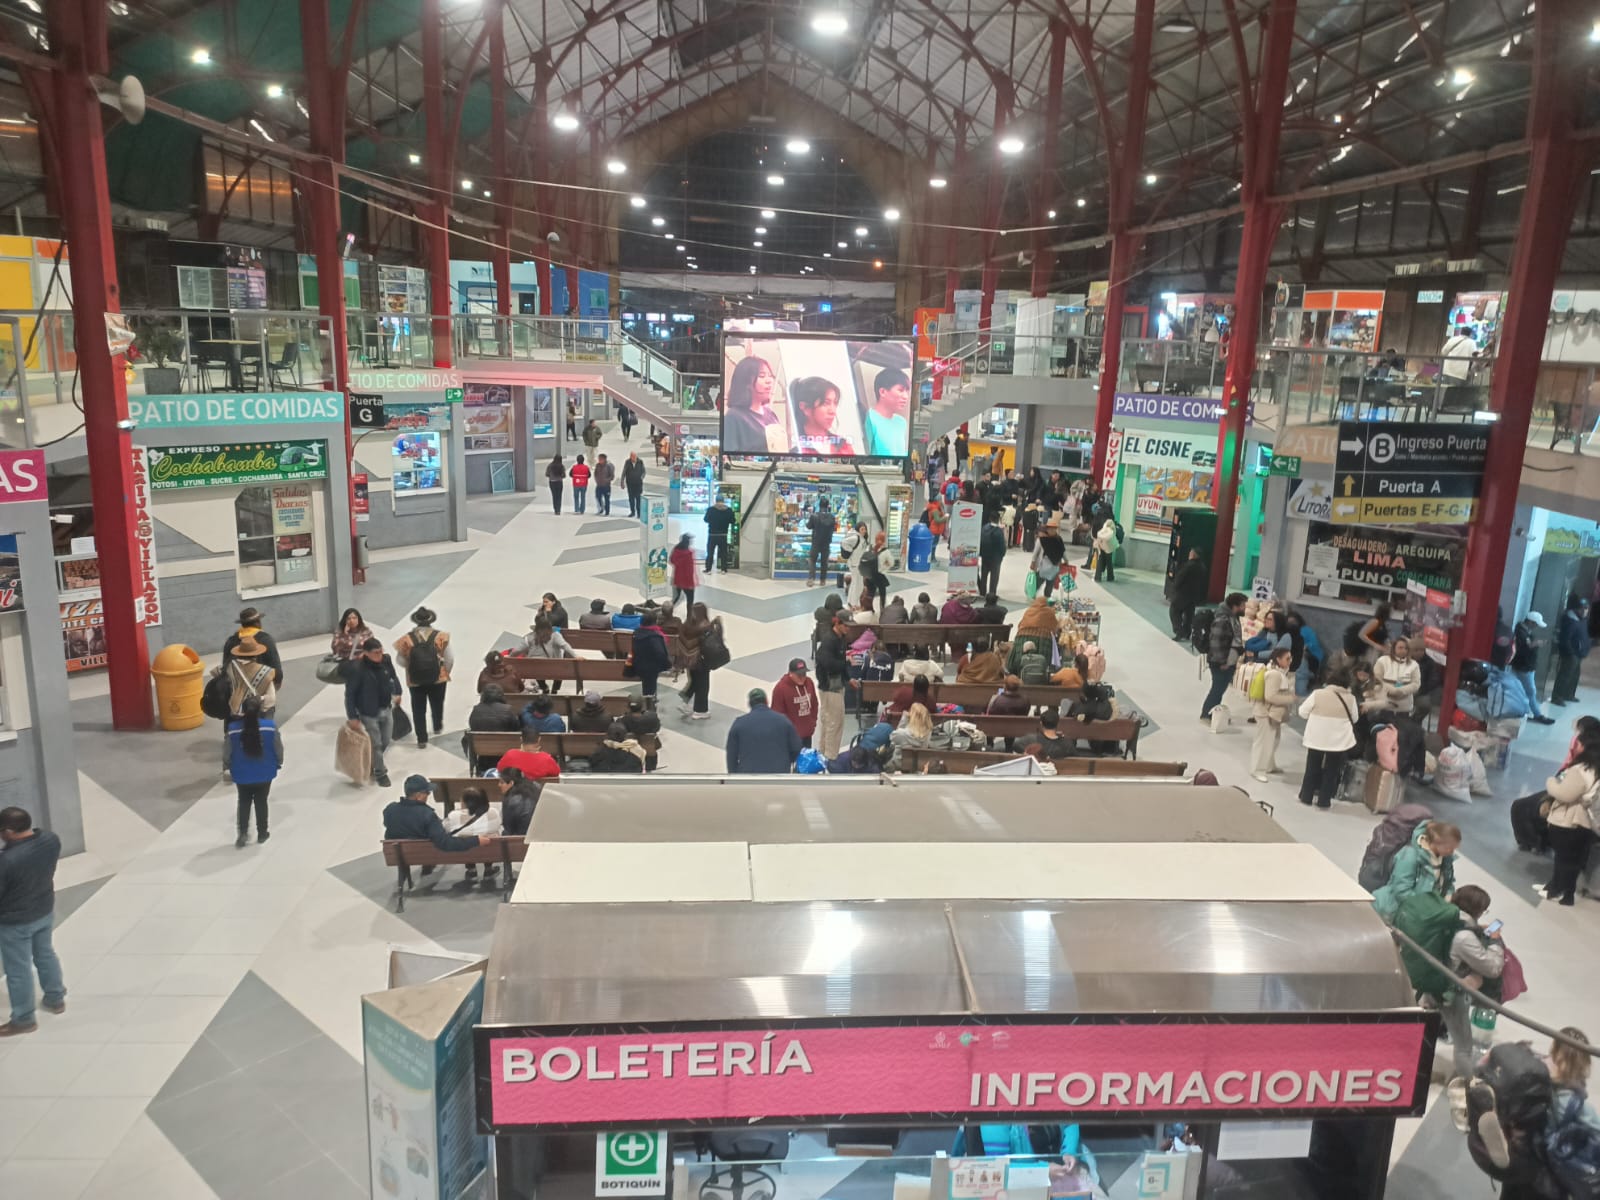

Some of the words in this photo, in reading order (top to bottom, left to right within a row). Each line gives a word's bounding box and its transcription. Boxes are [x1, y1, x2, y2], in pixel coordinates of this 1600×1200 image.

[376, 374, 394, 388] DE
[398, 374, 458, 388] COMIDAS
[130, 400, 200, 423] PATIO
[206, 399, 236, 420] DE
[241, 397, 338, 419] COMIDAS
[350, 396, 383, 406] Puerta
[1115, 396, 1157, 414] PATIO
[1160, 399, 1180, 416] DE
[359, 408, 373, 422] G
[168, 446, 220, 455] EXPRESO
[1124, 436, 1140, 453] EL
[1145, 438, 1192, 459] CISNE
[1374, 437, 1390, 458] B
[1397, 434, 1445, 452] Ingreso
[1447, 435, 1487, 451] Puerta
[152, 450, 277, 481] Cochabamba
[1105, 438, 1120, 489] UYUNI
[131, 448, 150, 521] TARIJA
[151, 481, 178, 489] POTOSI
[183, 479, 206, 487] UYUNI
[210, 477, 233, 485] SUCRE
[238, 474, 283, 483] COCHABAMBA
[287, 471, 308, 479] SANTA
[309, 470, 326, 478] CRUZ
[1379, 479, 1424, 493] Puerta
[1430, 480, 1441, 493] A
[1137, 498, 1161, 511] UYUNI
[1364, 503, 1417, 516] Puertas
[1332, 535, 1388, 553] DESAGUADERO
[1395, 544, 1451, 561] AREQUIPA
[1352, 550, 1406, 569] LIMA
[140, 537, 159, 625] VILLAZON
[1341, 567, 1394, 586] PUNO
[502, 1031, 813, 1083] BOLETERÍA
[969, 1068, 1402, 1107] INFORMACIONES
[601, 1178, 661, 1189] BOTIQUÍN
